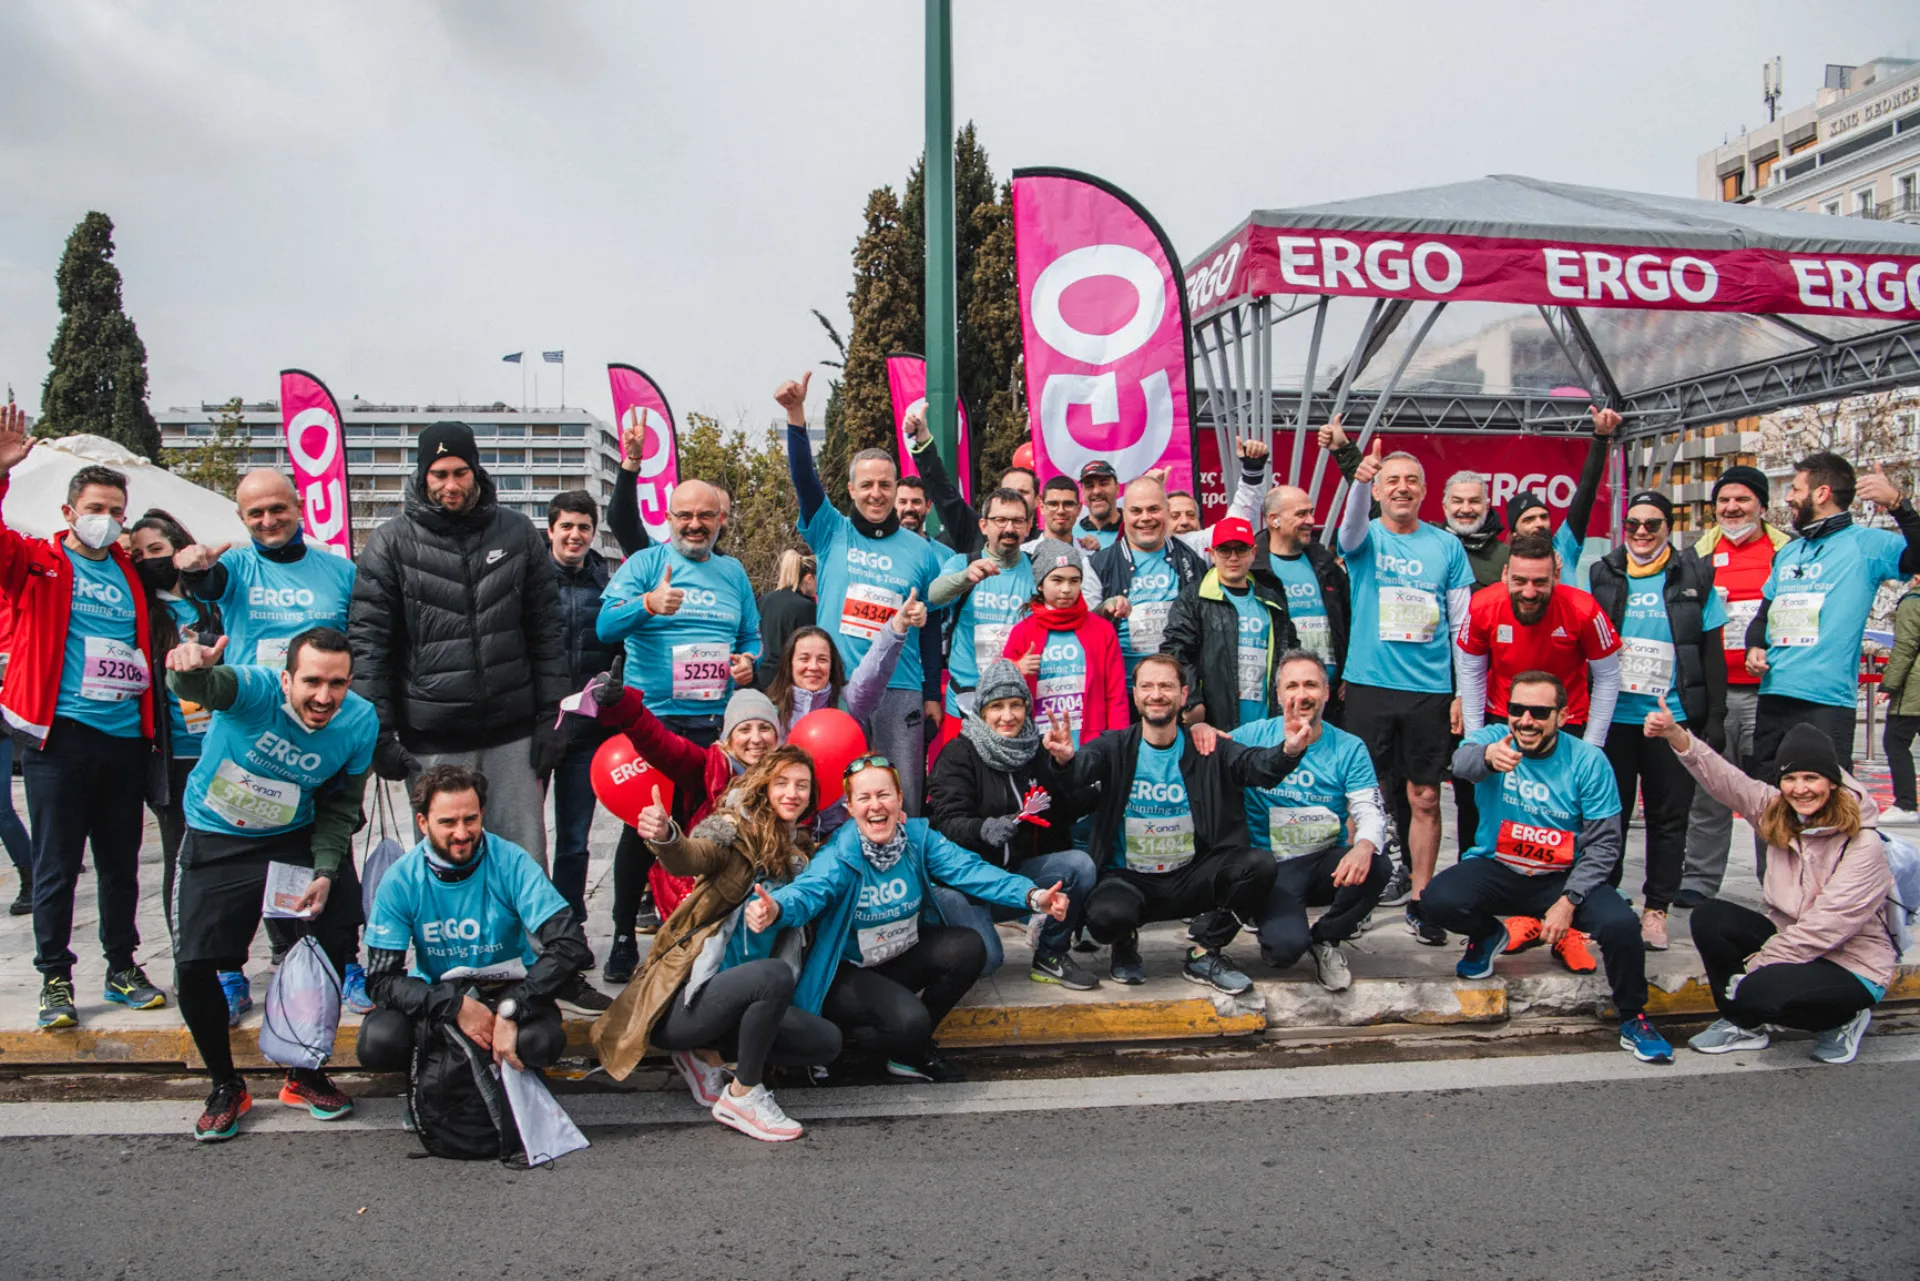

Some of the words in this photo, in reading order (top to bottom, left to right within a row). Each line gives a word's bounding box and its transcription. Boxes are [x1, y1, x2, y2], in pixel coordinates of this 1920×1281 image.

[1277, 236, 1462, 294] ERGO
[1542, 248, 1719, 303] ERGO
[847, 548, 892, 571] ERGO
[1131, 574, 1169, 591] RGO
[1283, 582, 1315, 597] RGO
[248, 587, 314, 608] ERGO
[682, 588, 716, 606] RGO
[974, 591, 1023, 611] ERGO
[1628, 592, 1659, 607] GO
[71, 602, 113, 617] unning
[249, 610, 304, 621] Running
[306, 610, 337, 621] Team
[1238, 616, 1263, 633] GO
[1042, 644, 1078, 662] RGO
[684, 663, 725, 680] 52526
[1620, 656, 1662, 676] 3684
[1042, 694, 1084, 715] 57004
[255, 730, 322, 772] ERGO
[244, 750, 299, 781] Running
[610, 757, 655, 785] ERG
[1284, 768, 1314, 788] GO
[1503, 770, 1550, 802] EGO
[1304, 792, 1333, 803] Team
[1511, 823, 1562, 846] ERGO
[1513, 843, 1556, 863] 4745
[856, 878, 908, 908] ERGO
[854, 907, 901, 921] Running
[470, 943, 504, 956] Team
